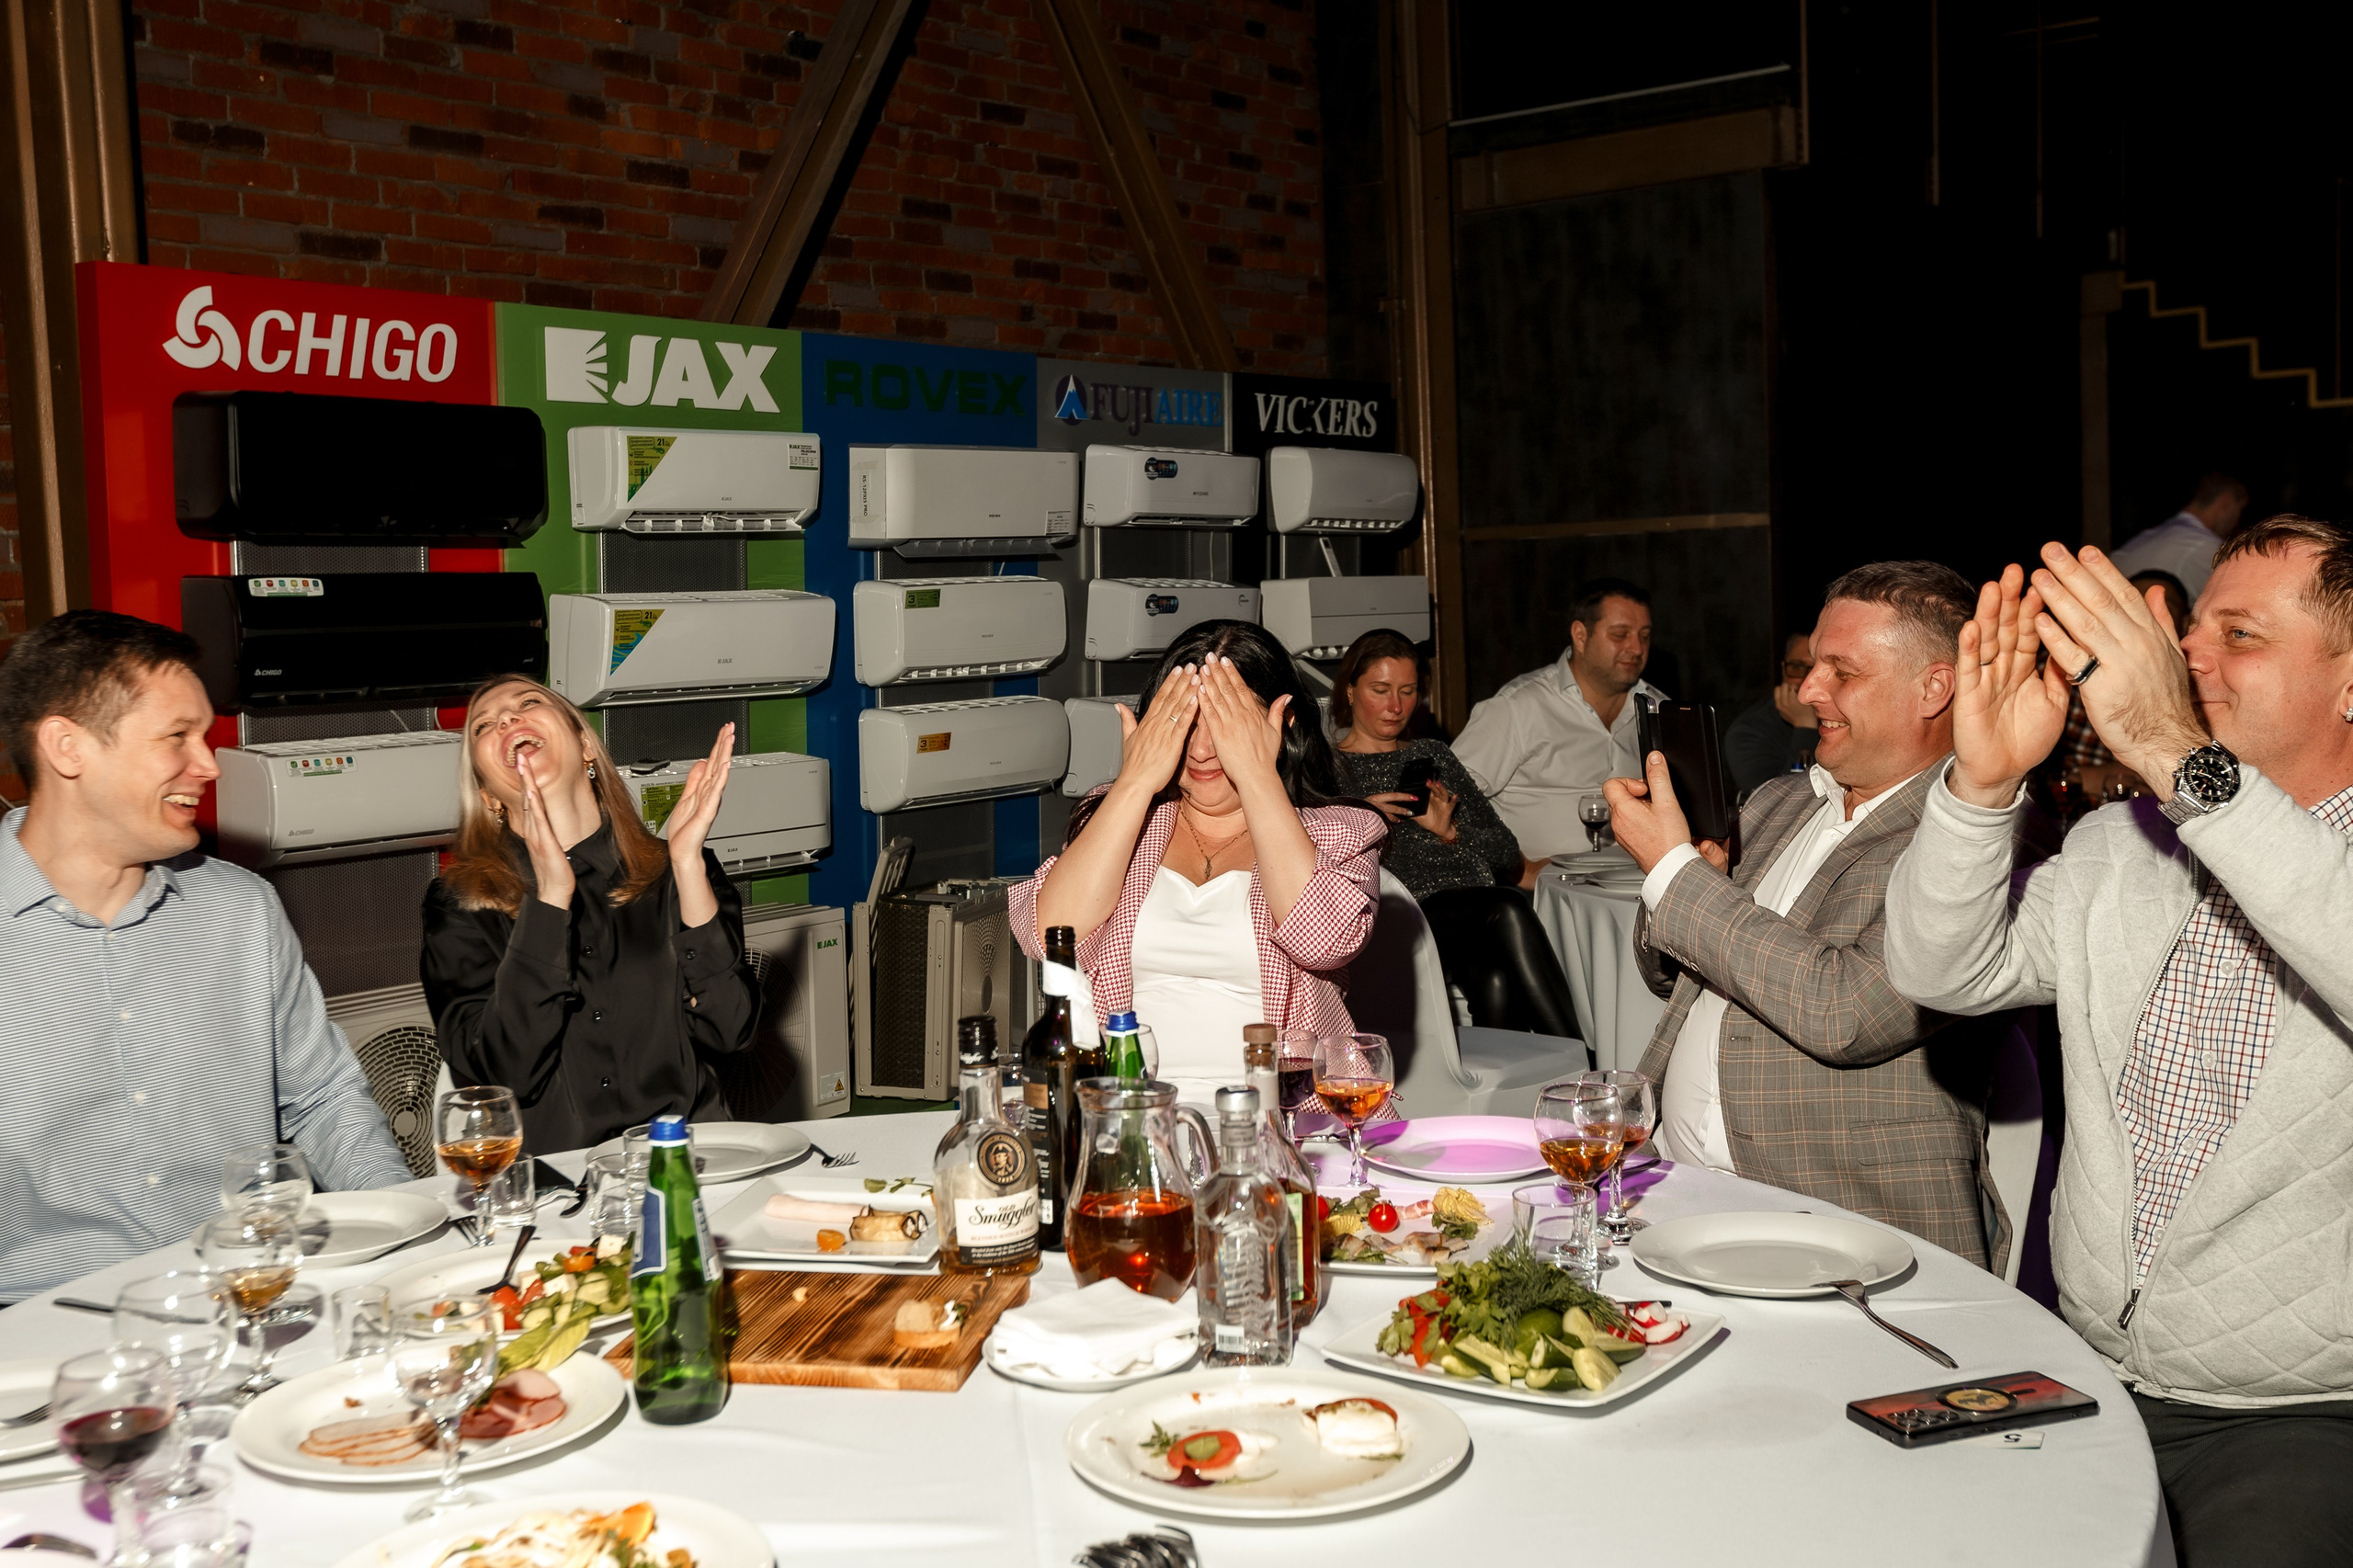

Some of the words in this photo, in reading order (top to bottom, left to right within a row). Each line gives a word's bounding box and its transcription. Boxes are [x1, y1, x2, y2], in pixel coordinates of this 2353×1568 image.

[247, 310, 458, 382] CHIGO
[611, 334, 781, 414] JAX
[824, 358, 1029, 416] ROVEX
[1255, 392, 1379, 437] VICKERS
[644, 611, 653, 619] 21
[908, 595, 915, 604] 3
[920, 739, 927, 748] 3
[823, 937, 838, 949] JAX
[969, 1196, 1037, 1230] Smuggler
